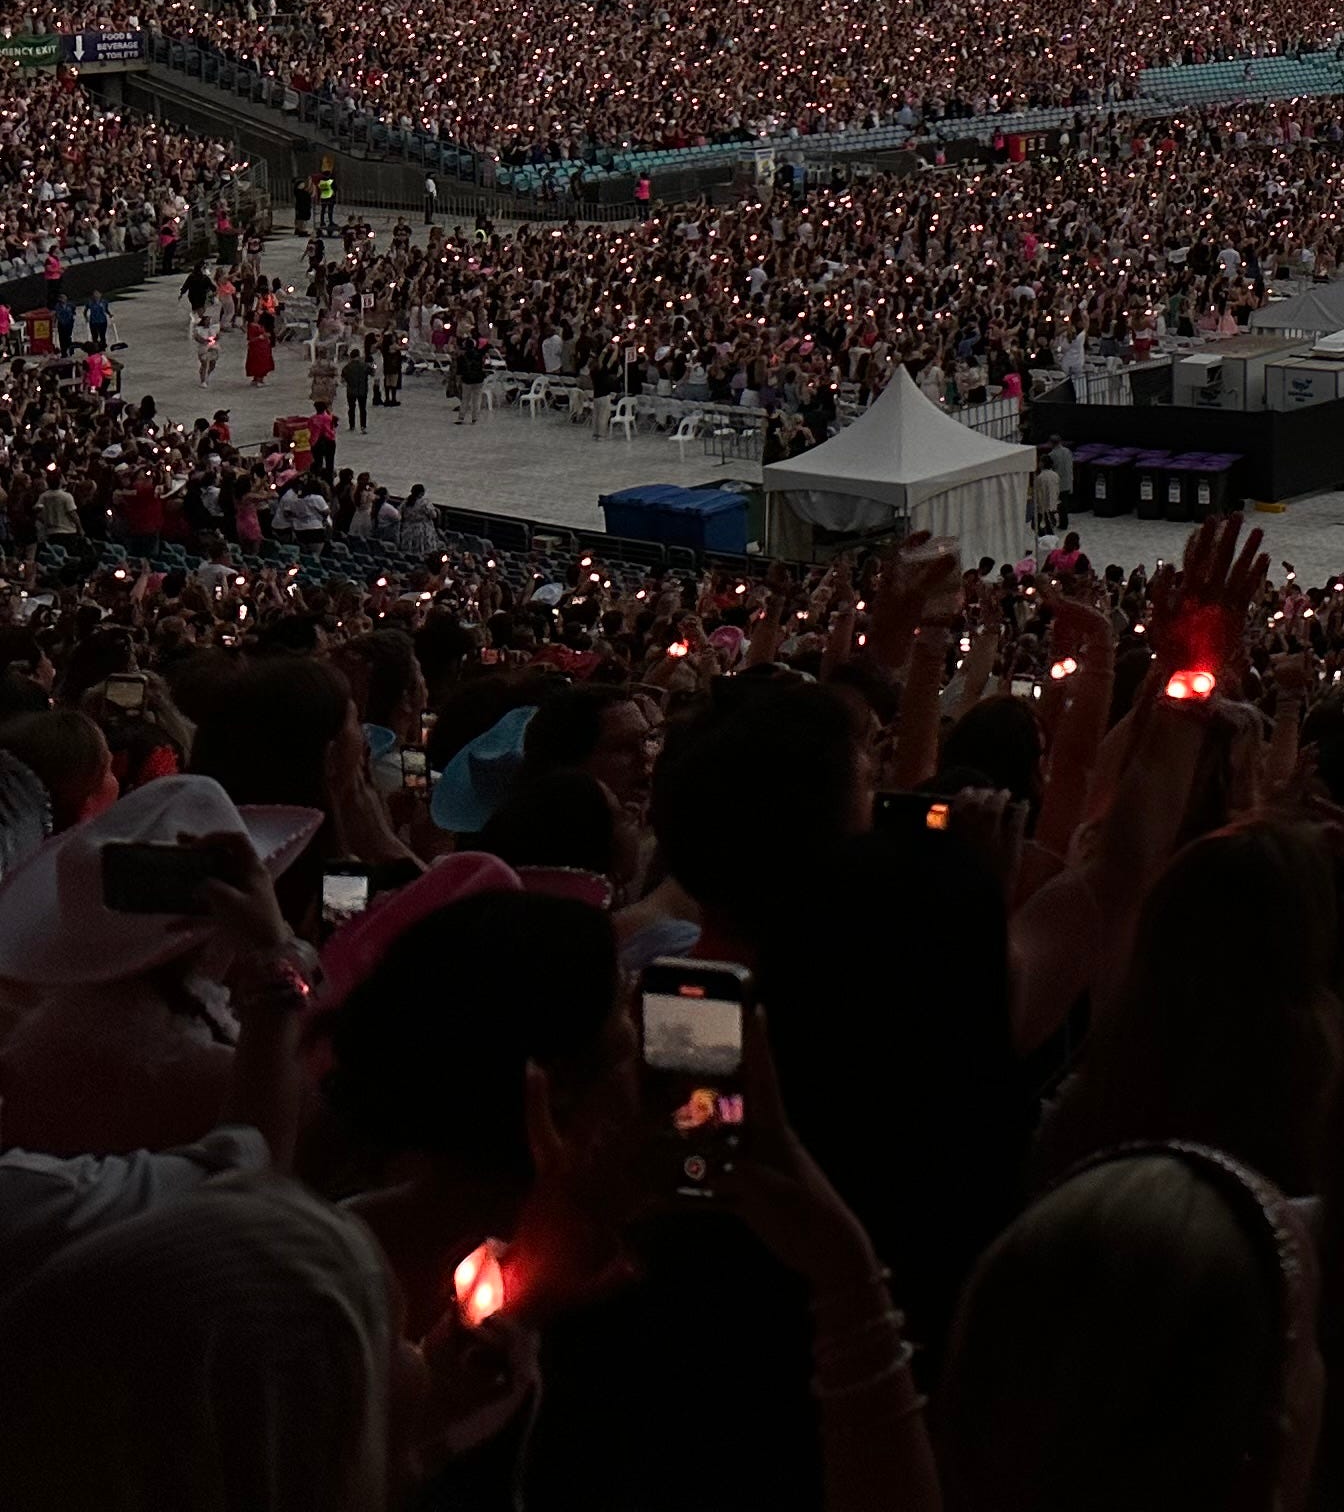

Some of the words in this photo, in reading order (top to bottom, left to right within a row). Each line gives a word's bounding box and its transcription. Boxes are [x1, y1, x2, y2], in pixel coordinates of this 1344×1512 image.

[102, 32, 125, 41] FOOD
[0, 47, 33, 56] GENCY
[36, 45, 57, 55] EXIT
[97, 41, 138, 51] BEVERAGE
[105, 50, 139, 60] TOILETS
